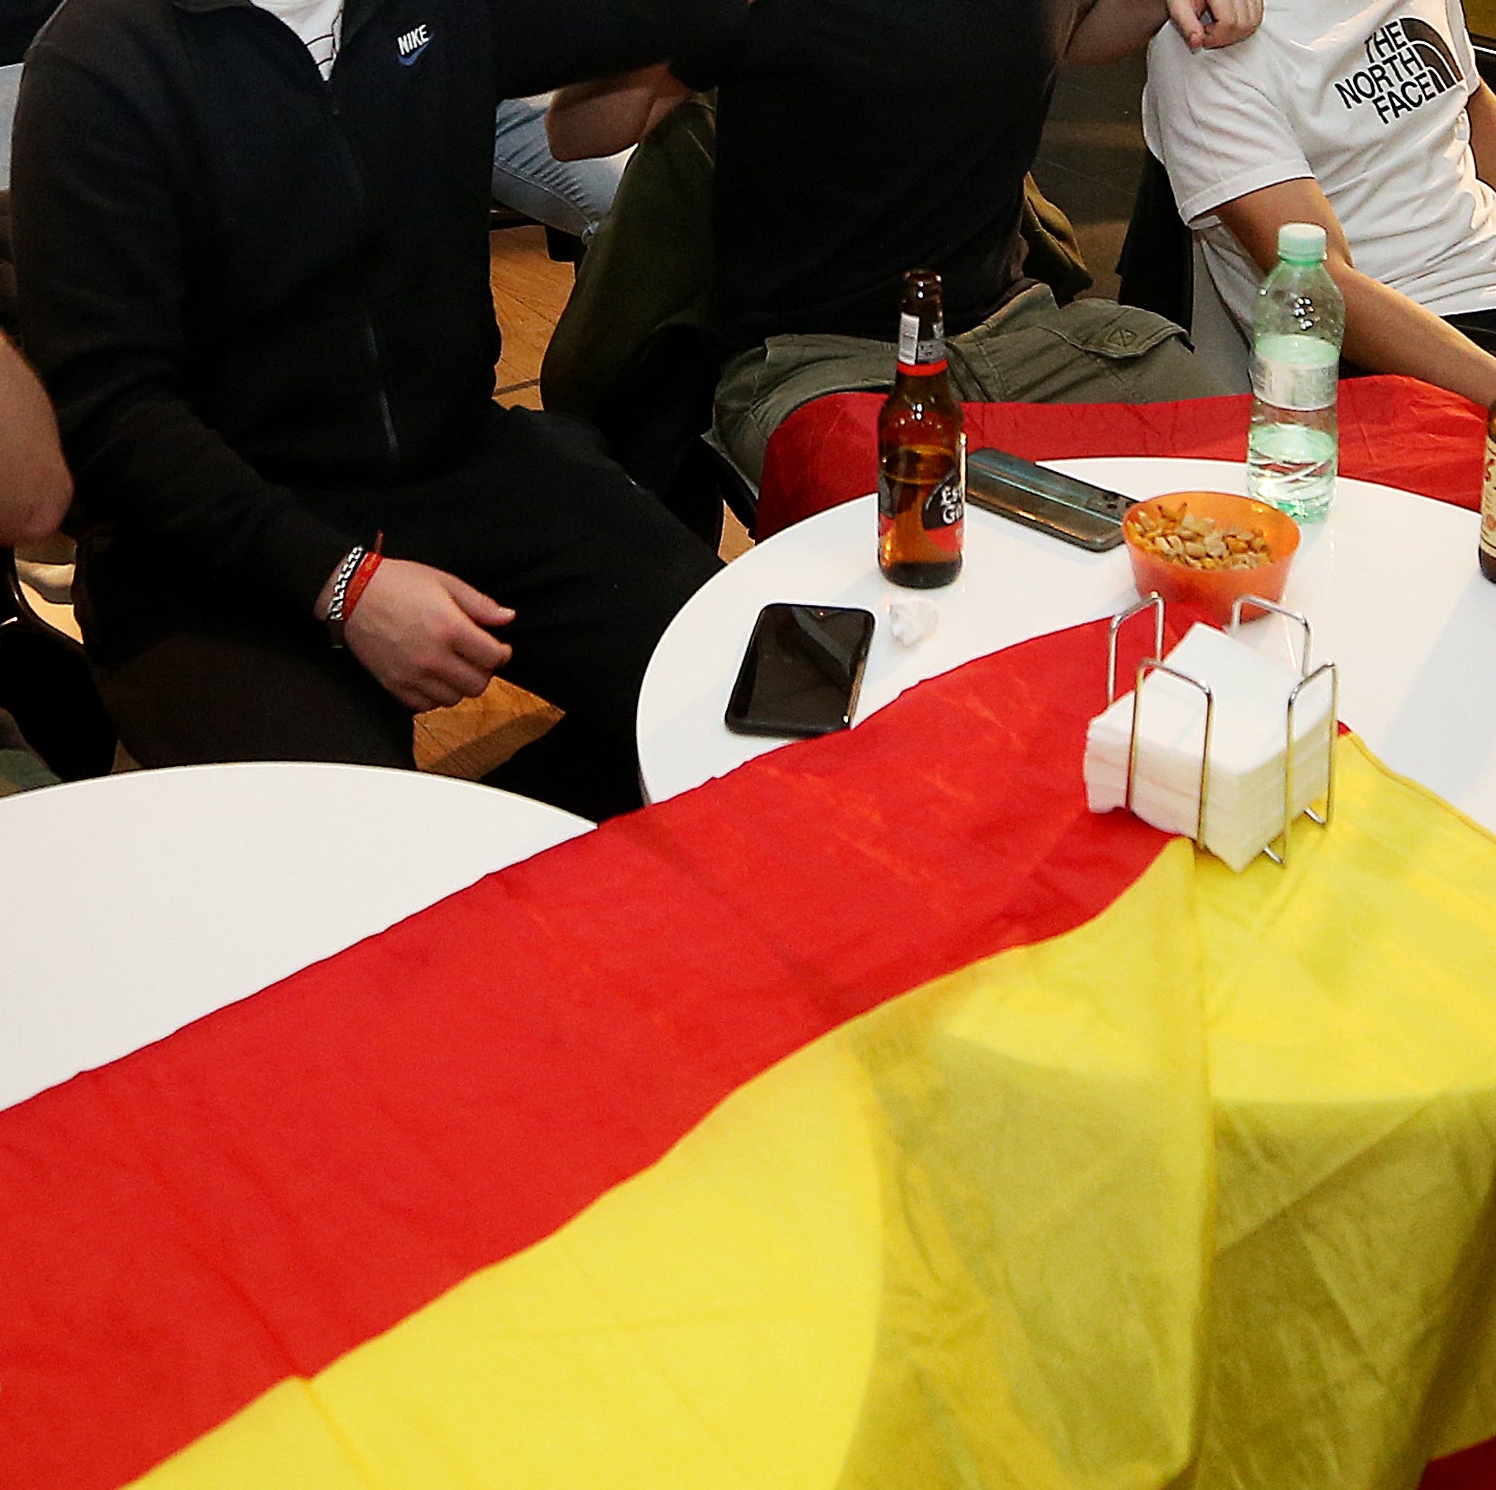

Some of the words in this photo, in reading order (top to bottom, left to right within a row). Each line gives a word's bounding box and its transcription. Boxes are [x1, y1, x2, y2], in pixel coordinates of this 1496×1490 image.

[397, 24, 429, 56] NIKE
[1364, 21, 1407, 63] THE
[1334, 46, 1424, 109] NORTH
[1372, 72, 1436, 124] FACE
